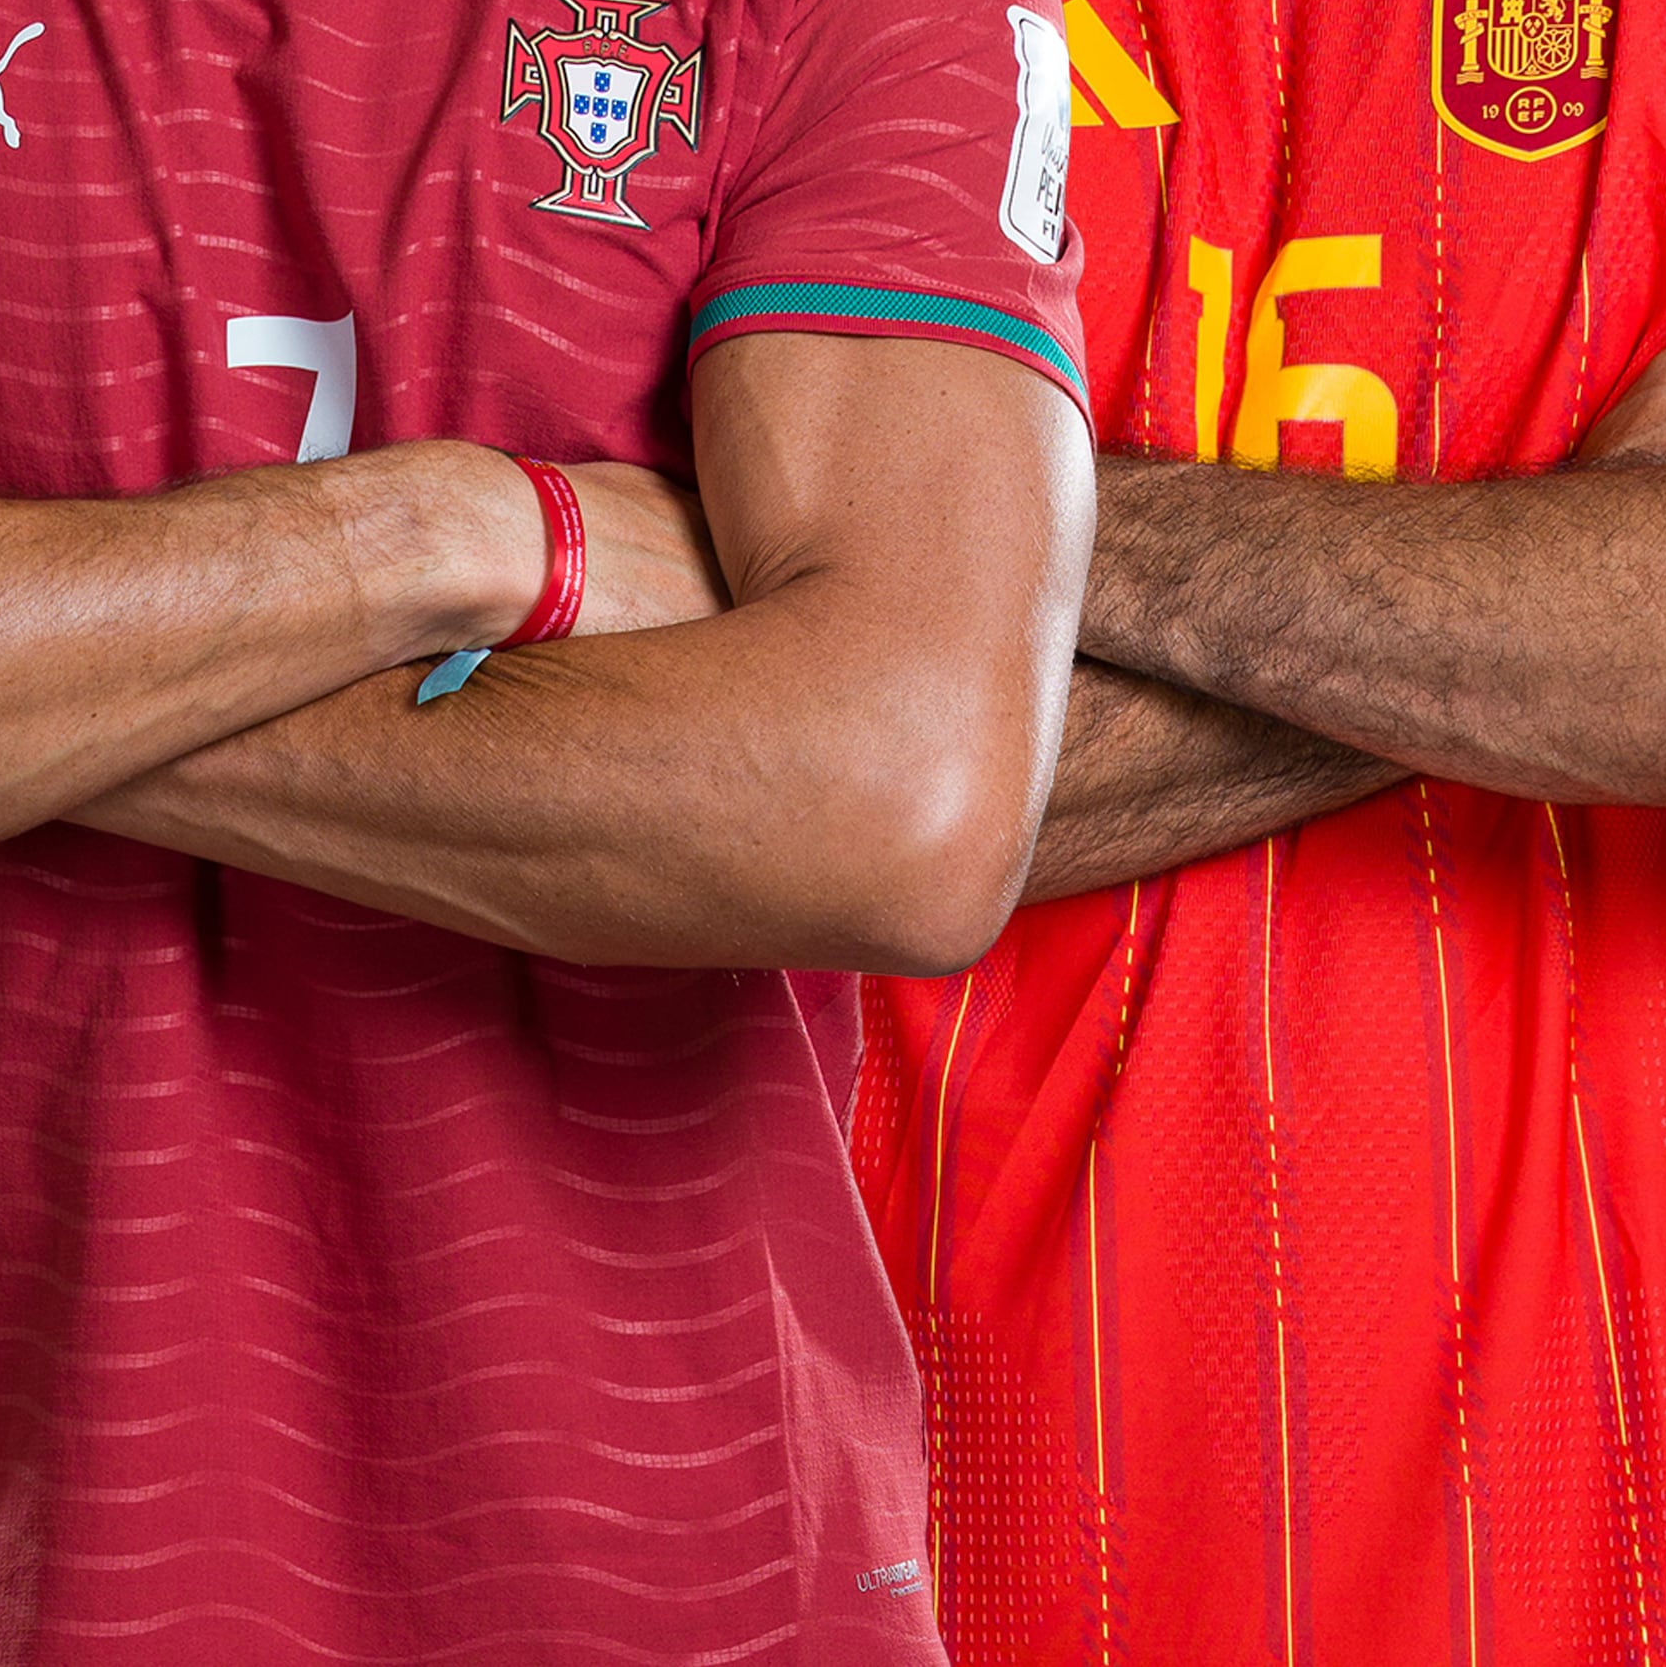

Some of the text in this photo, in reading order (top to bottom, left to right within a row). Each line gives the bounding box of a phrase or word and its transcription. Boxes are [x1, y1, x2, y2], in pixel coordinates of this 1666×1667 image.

[1482, 101, 1584, 119] 19 09
[226, 310, 357, 463] 7
[1188, 234, 1398, 483] 16
